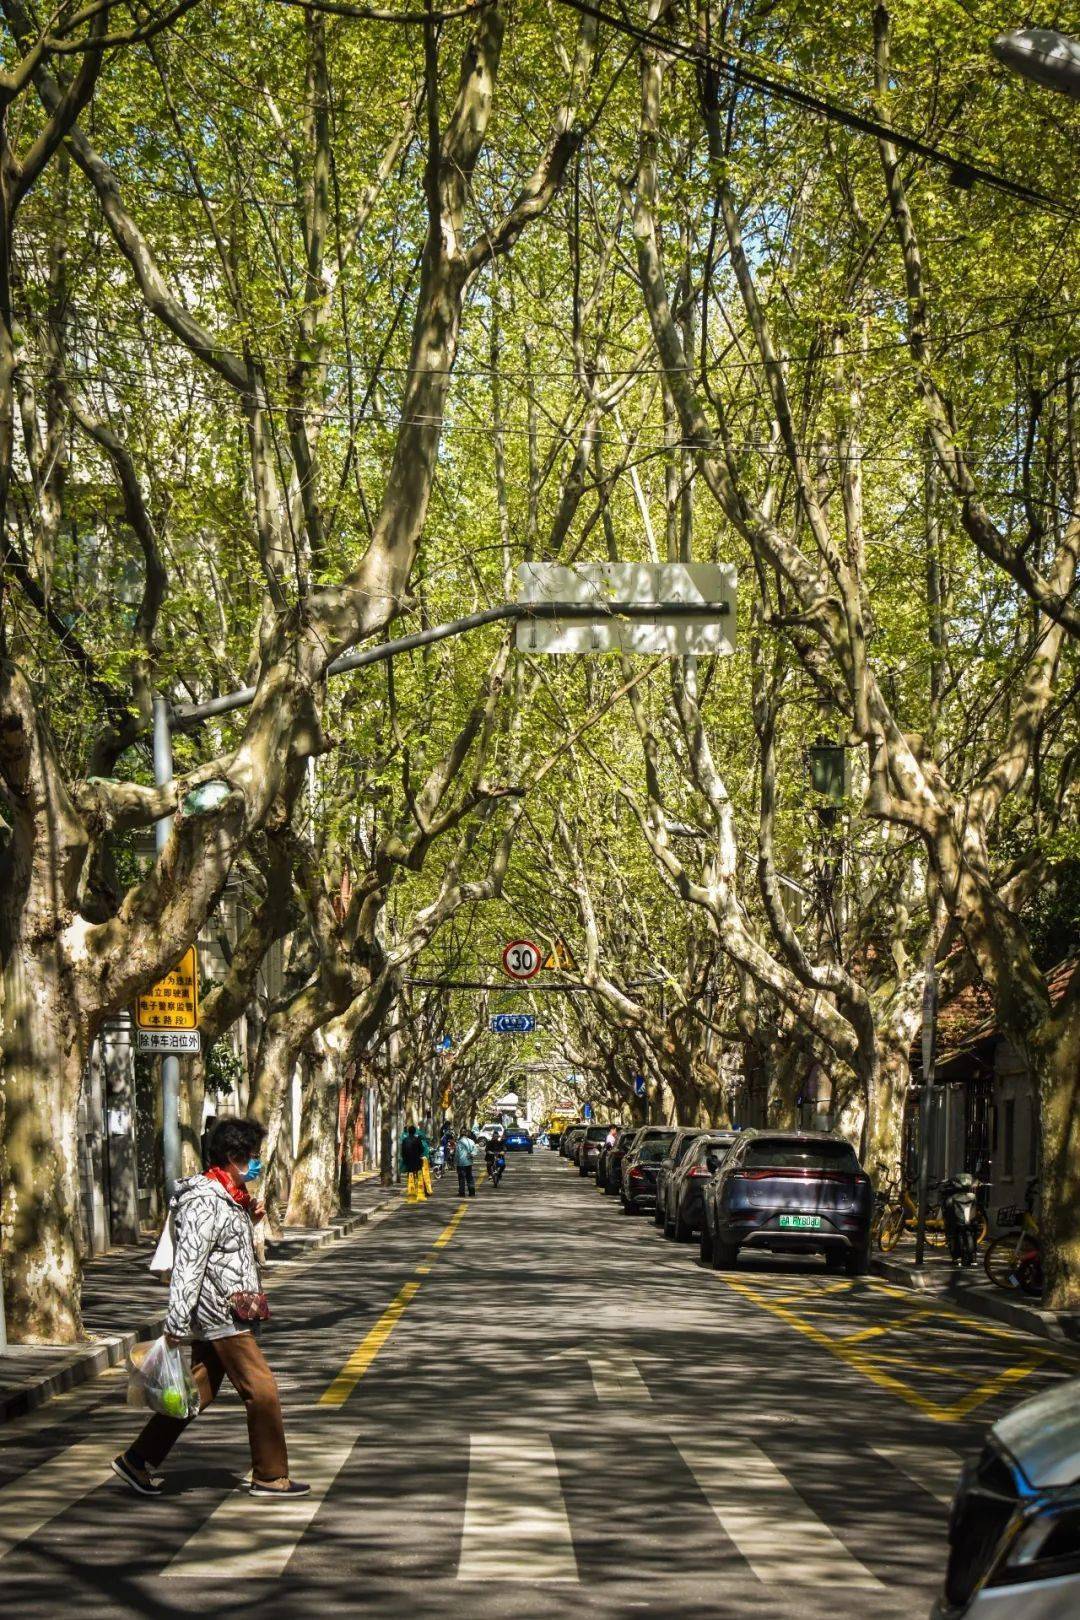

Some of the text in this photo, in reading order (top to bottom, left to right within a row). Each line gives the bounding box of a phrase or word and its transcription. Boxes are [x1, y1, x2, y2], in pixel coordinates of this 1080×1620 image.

[512, 949, 532, 970] 30
[148, 988, 189, 998] 立即驶离
[140, 1034, 198, 1047] 除停车泊位外
